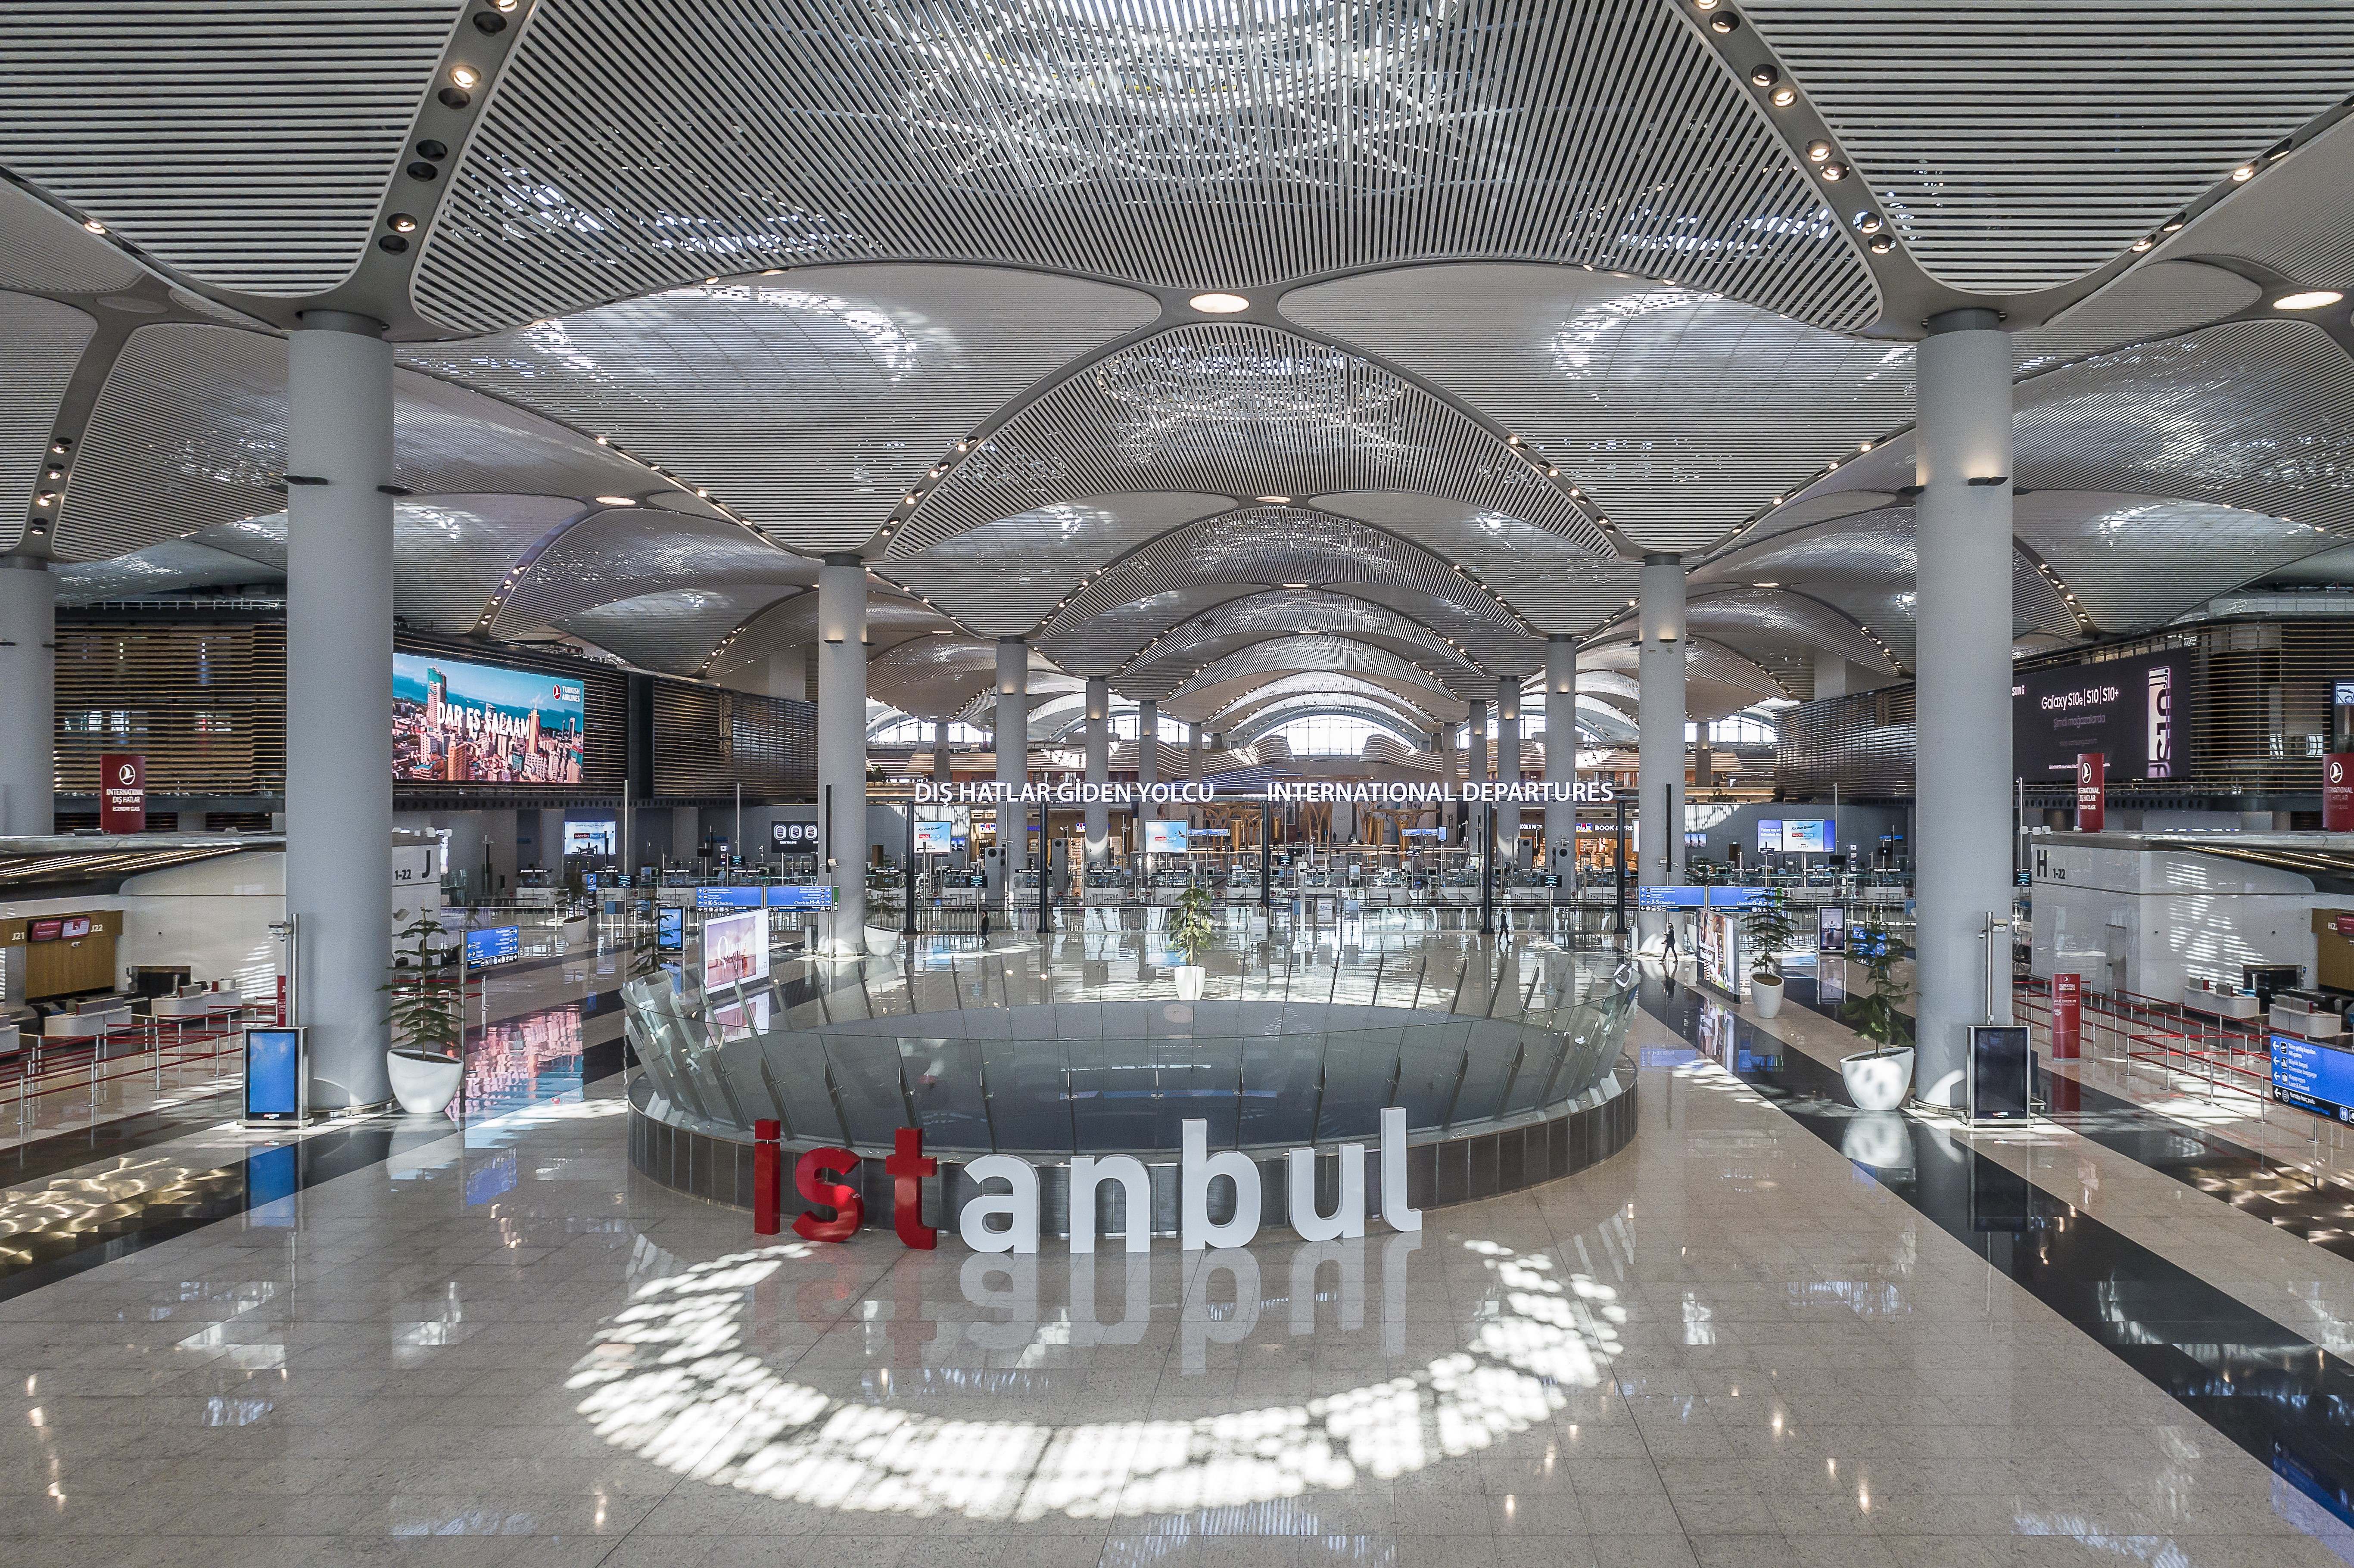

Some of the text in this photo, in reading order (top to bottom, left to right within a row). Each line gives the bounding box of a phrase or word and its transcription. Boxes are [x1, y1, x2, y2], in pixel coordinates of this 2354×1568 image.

[562, 686, 579, 694] TURKISH
[562, 694, 580, 702] AIRLINES
[2041, 695, 2068, 710] Galaxy
[437, 702, 530, 739] DAR ES SALAAM
[915, 778, 1614, 807] DIŞ HATLAR GİDEN YOLCU INTERNATIONAL DEPARTURES
[395, 850, 431, 880] 1-22 J
[2037, 849, 2066, 879] H 1-22
[12, 932, 25, 940] J21
[90, 924, 103, 932] J22
[753, 1106, 1423, 1254] istanbul
